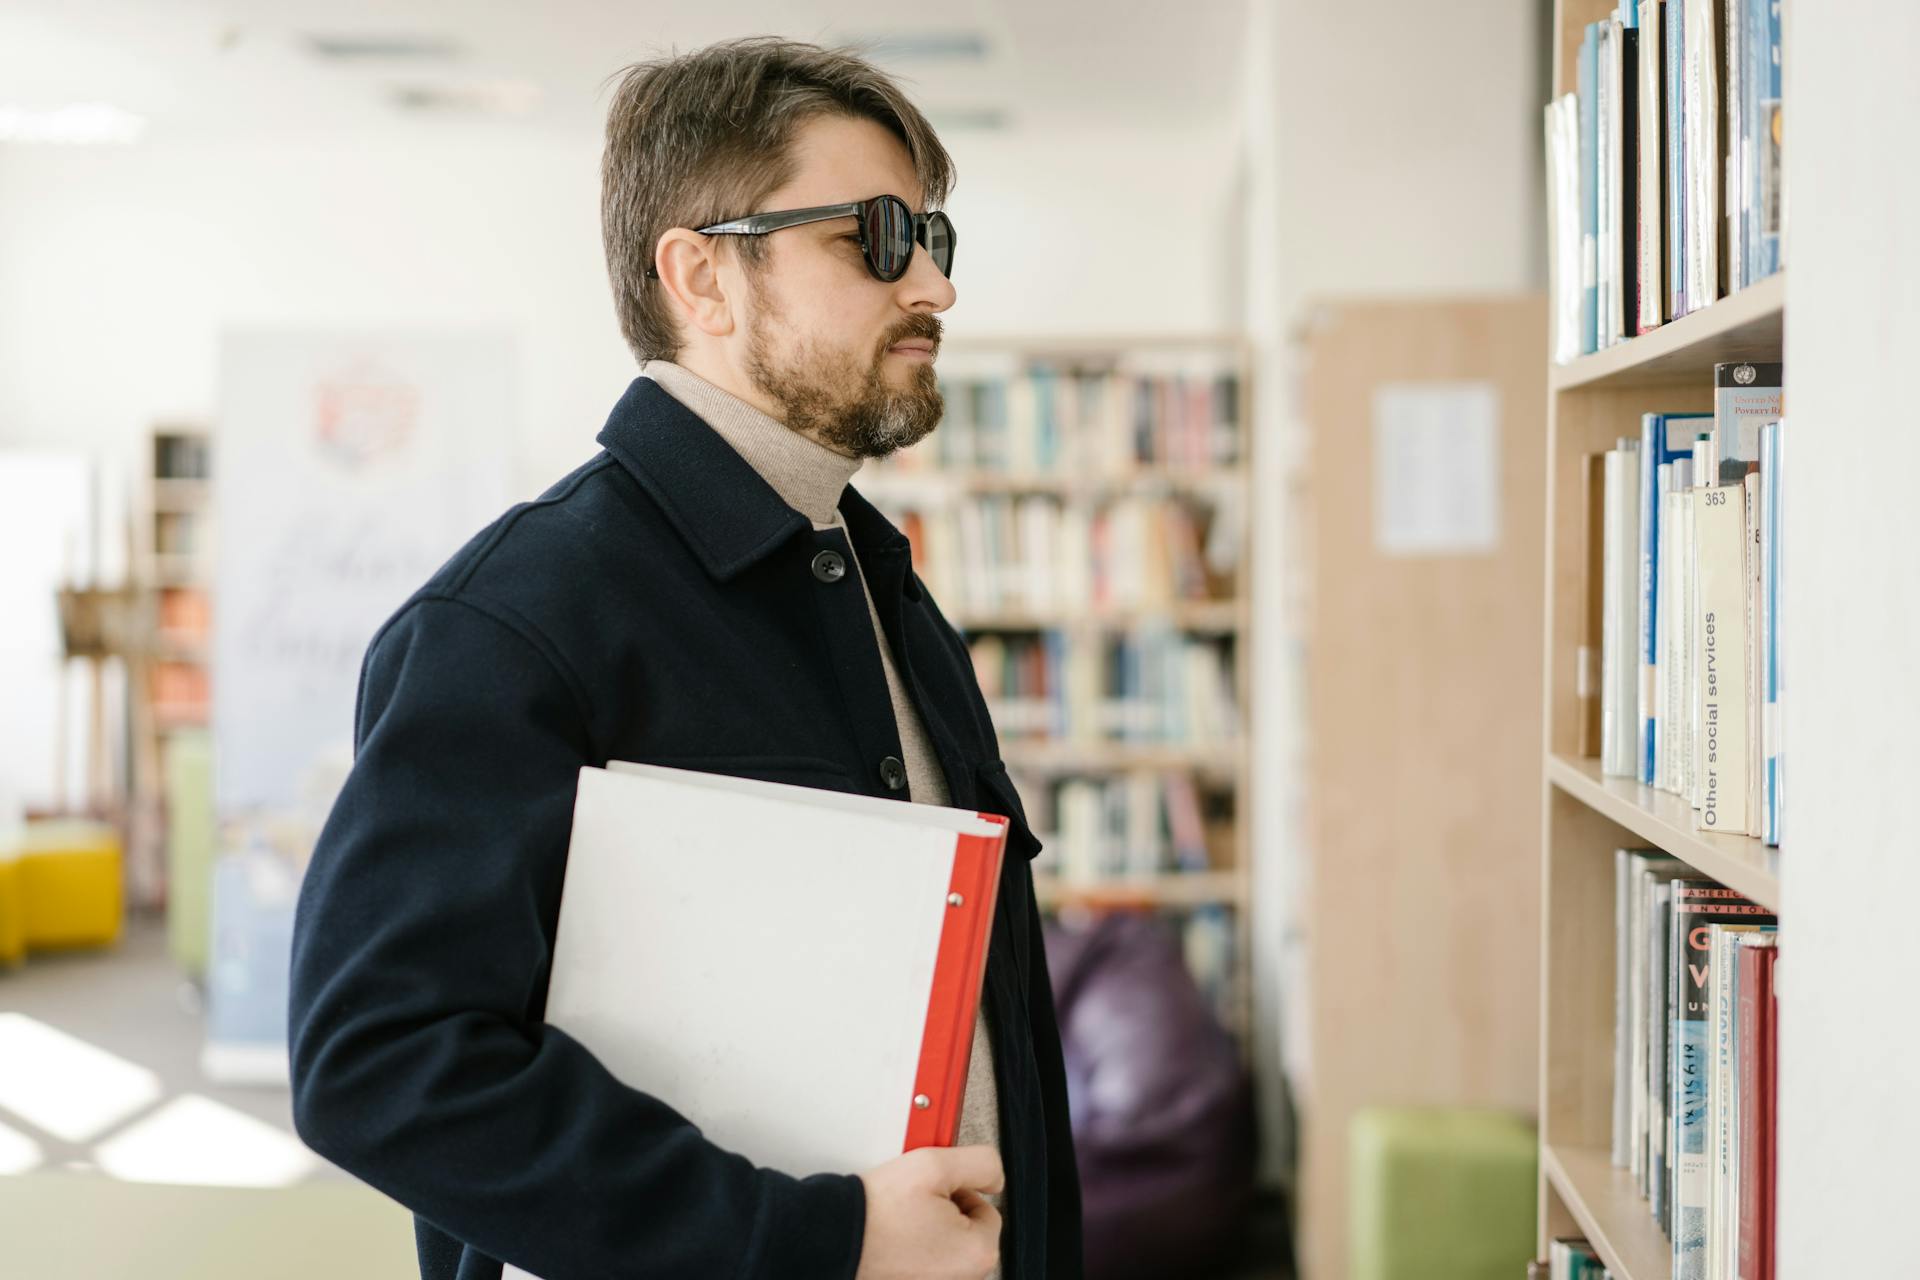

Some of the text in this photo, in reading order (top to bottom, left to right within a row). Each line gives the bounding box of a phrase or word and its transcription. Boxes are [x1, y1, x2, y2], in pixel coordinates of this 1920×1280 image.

[1735, 406, 1768, 415] POVERTY
[1705, 491, 1726, 506] 363
[1705, 612, 1718, 826] Other social services
